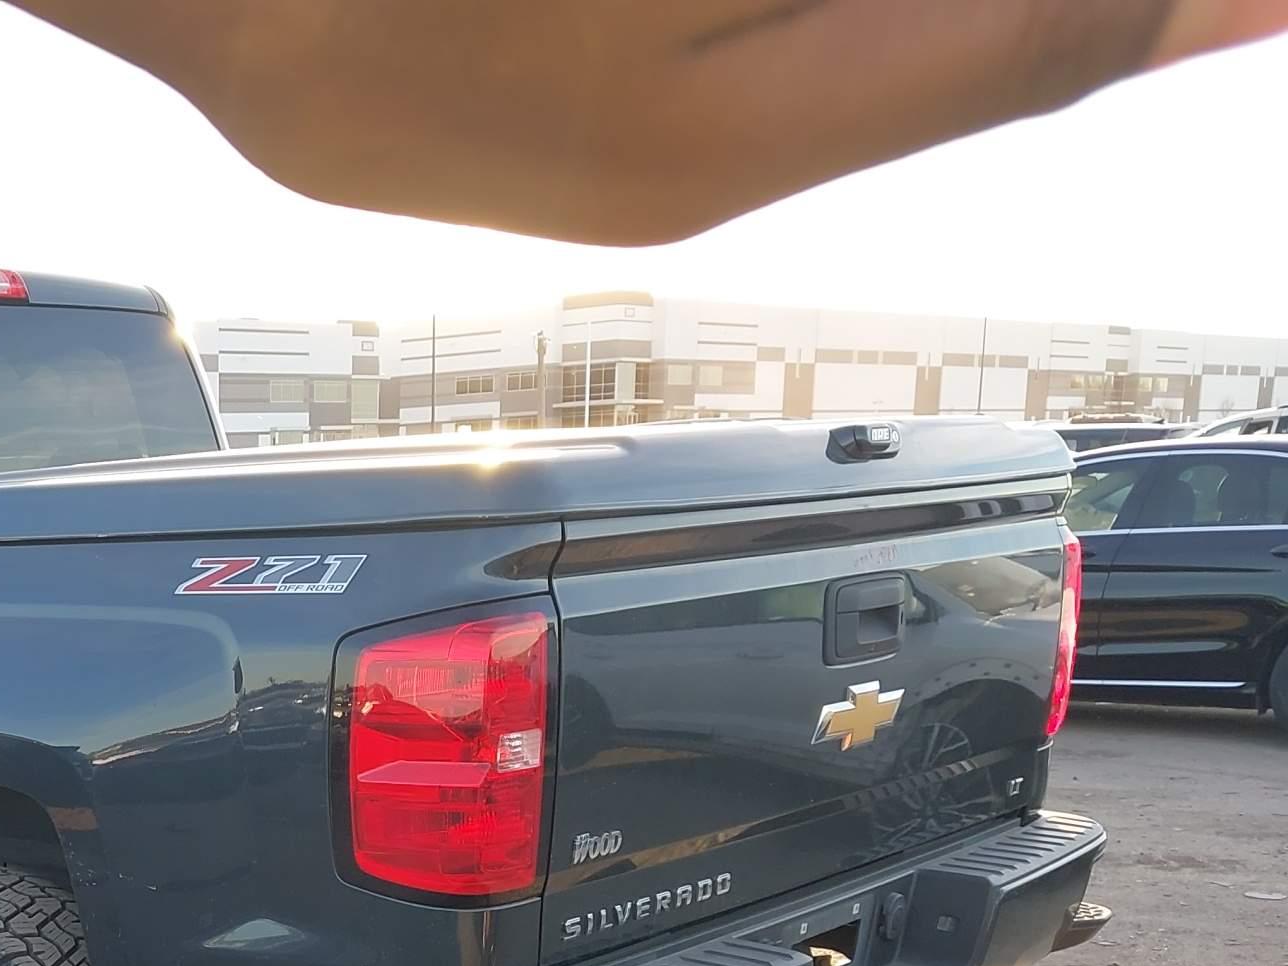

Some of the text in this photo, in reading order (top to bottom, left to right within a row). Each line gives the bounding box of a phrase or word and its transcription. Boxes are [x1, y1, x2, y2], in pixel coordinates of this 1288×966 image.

[175, 555, 368, 594] Z71
[277, 584, 344, 592] OFF ROAD
[1009, 777, 1024, 796] LT
[573, 830, 623, 865] WOOD
[562, 872, 732, 941] SILVERADO
